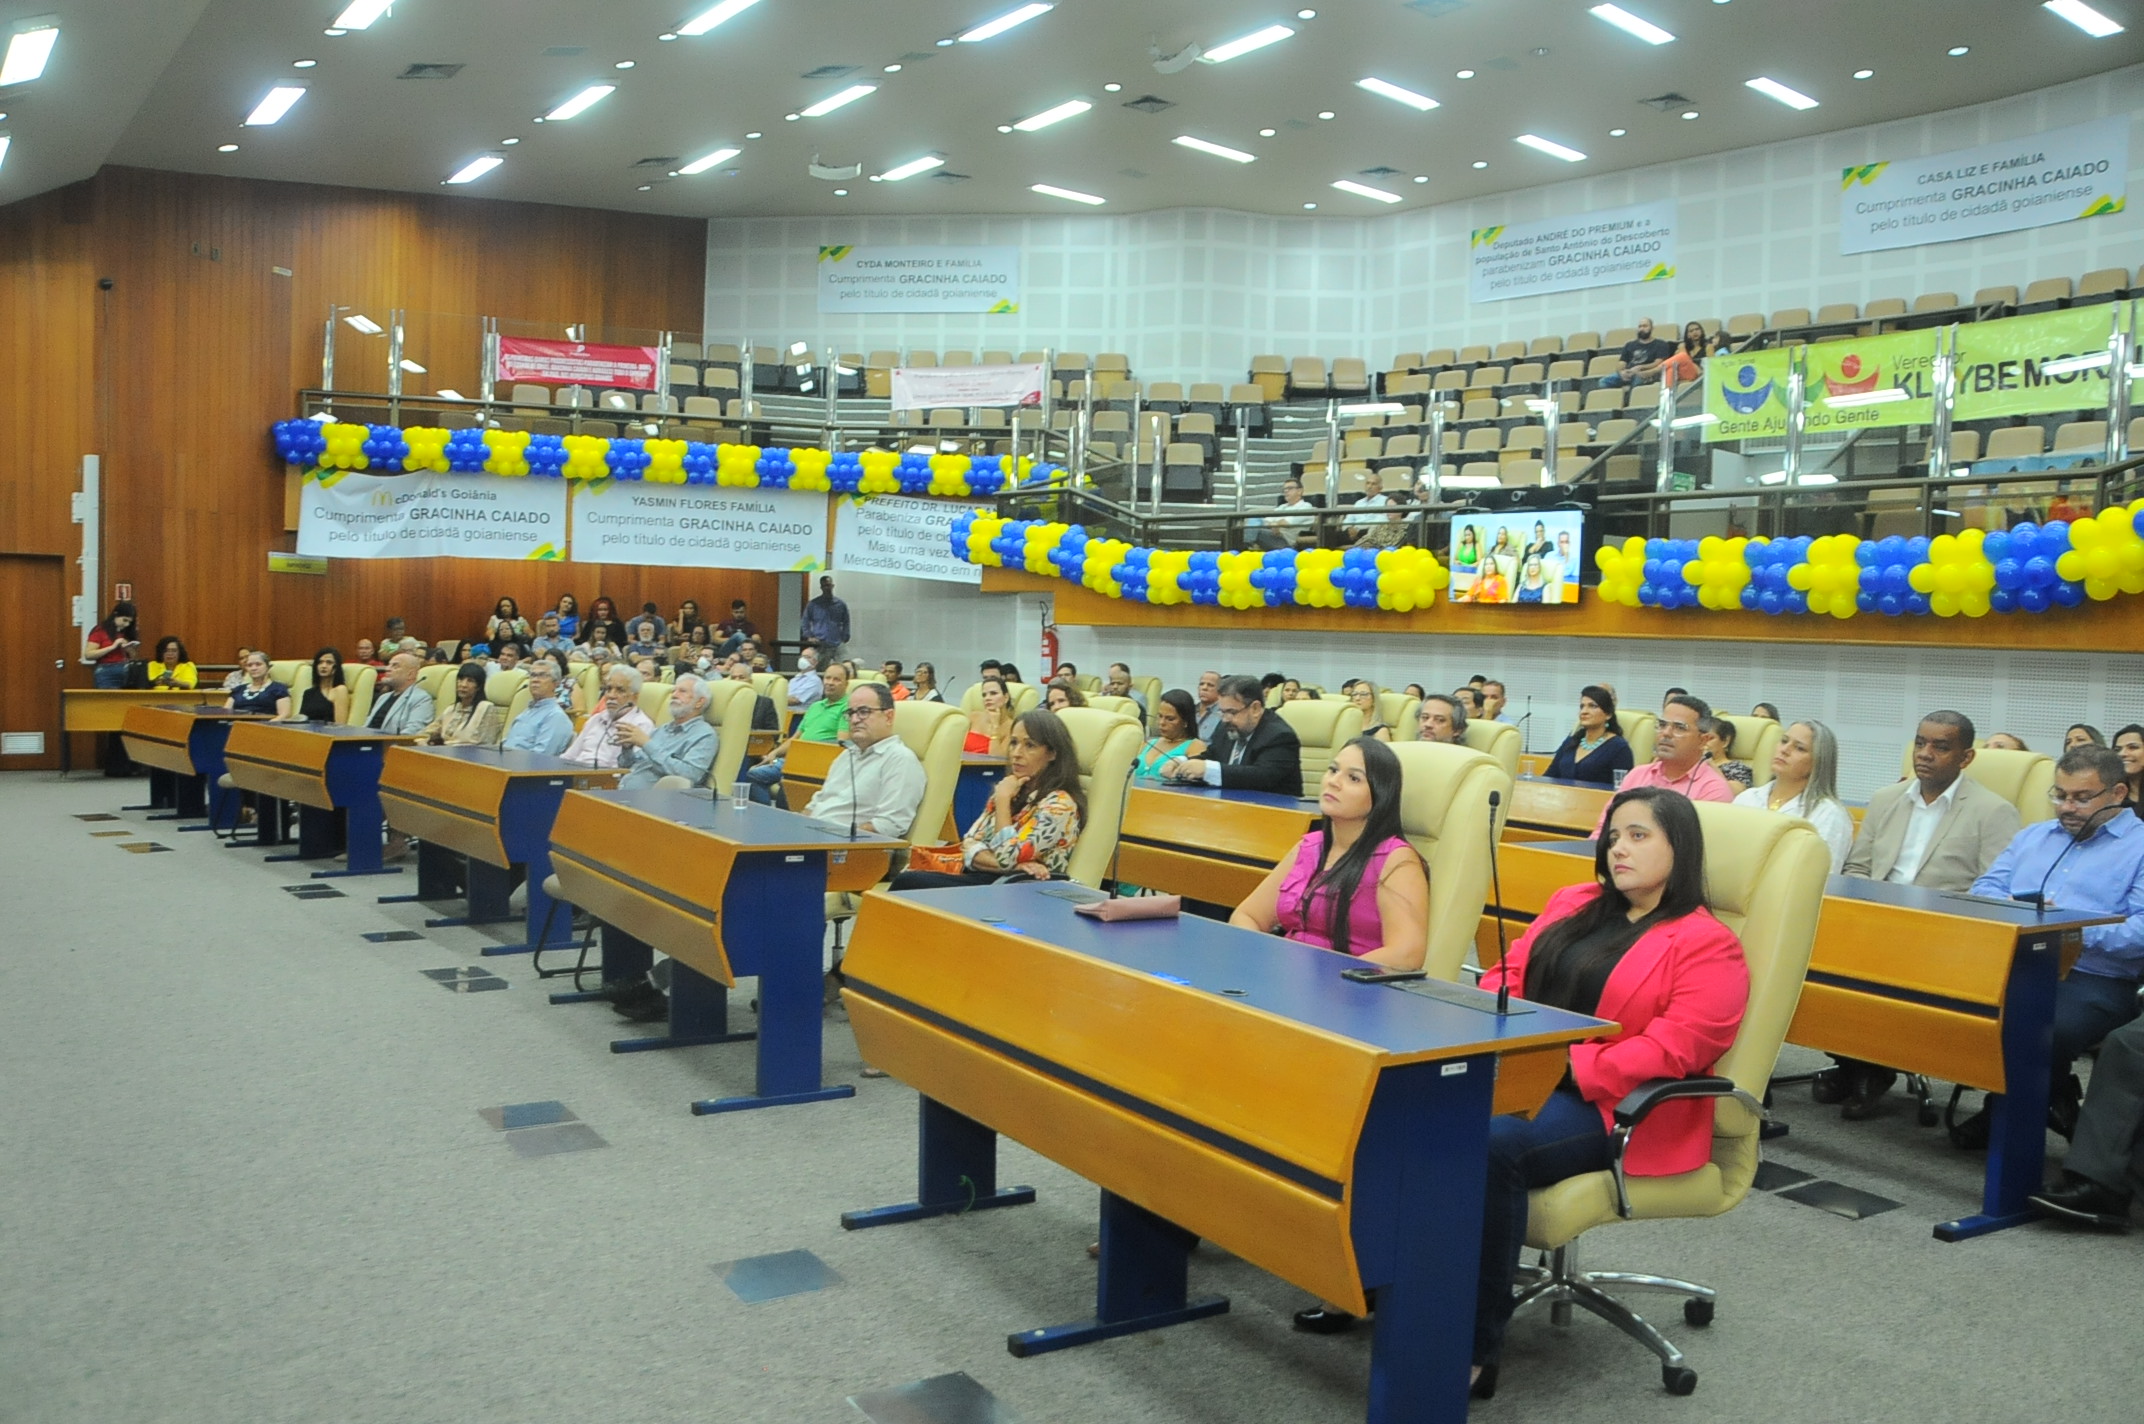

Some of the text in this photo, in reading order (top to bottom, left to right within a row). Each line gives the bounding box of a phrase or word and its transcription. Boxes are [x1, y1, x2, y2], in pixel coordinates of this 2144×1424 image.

[1917, 151, 2046, 186] CASA LIZ E FAMÍLIA
[1856, 159, 2110, 215] Cumprimenta GRACINHA CAIADO
[1870, 217, 1899, 233] pelo
[1940, 208, 1958, 222] de
[1961, 199, 2008, 219] cidadã
[2011, 184, 2094, 212] goianiense
[1492, 236, 1535, 250] Deputado
[1536, 229, 1570, 243] ANDRÉ
[1571, 227, 1586, 238] DO
[1588, 219, 1635, 235] PREMIUM
[1475, 250, 1520, 265] população
[1521, 248, 1533, 257] de
[1535, 244, 1561, 255] Santo
[1601, 236, 1613, 245] do
[1615, 227, 1671, 243] Descoberto
[856, 260, 882, 268] CYDA
[885, 260, 934, 268] MONTEIRO
[1482, 240, 1661, 277] parabenizam GRACINHA CAIADO
[828, 274, 1007, 286] Cumprimenta GRACINHA CAIADO
[1490, 276, 1511, 290] pelo
[1540, 271, 1553, 282] de
[1593, 258, 1651, 277] goianiense
[840, 288, 861, 300] pelo
[890, 288, 904, 298] de
[905, 288, 939, 298] cidadã
[942, 288, 998, 300] goianiense
[1893, 351, 1966, 370] Vereor
[1893, 360, 2018, 400] KLYBE
[1719, 419, 1759, 434] Gente
[1835, 408, 1880, 425] Gente
[450, 488, 497, 501] Goiânia
[864, 495, 919, 510] PREFEITO
[921, 501, 940, 512] DR.
[631, 496, 776, 513] YASMIN FLORES FAMÍLIA
[314, 506, 551, 524] Cumprimenta GRACINHA CAIADO
[587, 511, 813, 536] Cumprimenta GRACINHA CAIADO
[855, 507, 921, 524] Parabeniza
[329, 530, 360, 542] pelo
[401, 527, 416, 539] de
[419, 526, 460, 539] cidadã
[464, 528, 538, 542] goianiense
[602, 532, 630, 546] pelo
[669, 534, 685, 547] de
[688, 535, 730, 549] cidadã
[734, 538, 801, 552] goianiense
[858, 525, 883, 536] pelo
[917, 528, 933, 541] de
[868, 540, 949, 559] Mais uma vez
[844, 553, 902, 570] Mercadão
[904, 559, 948, 574] Goiano
[951, 566, 971, 576] em
